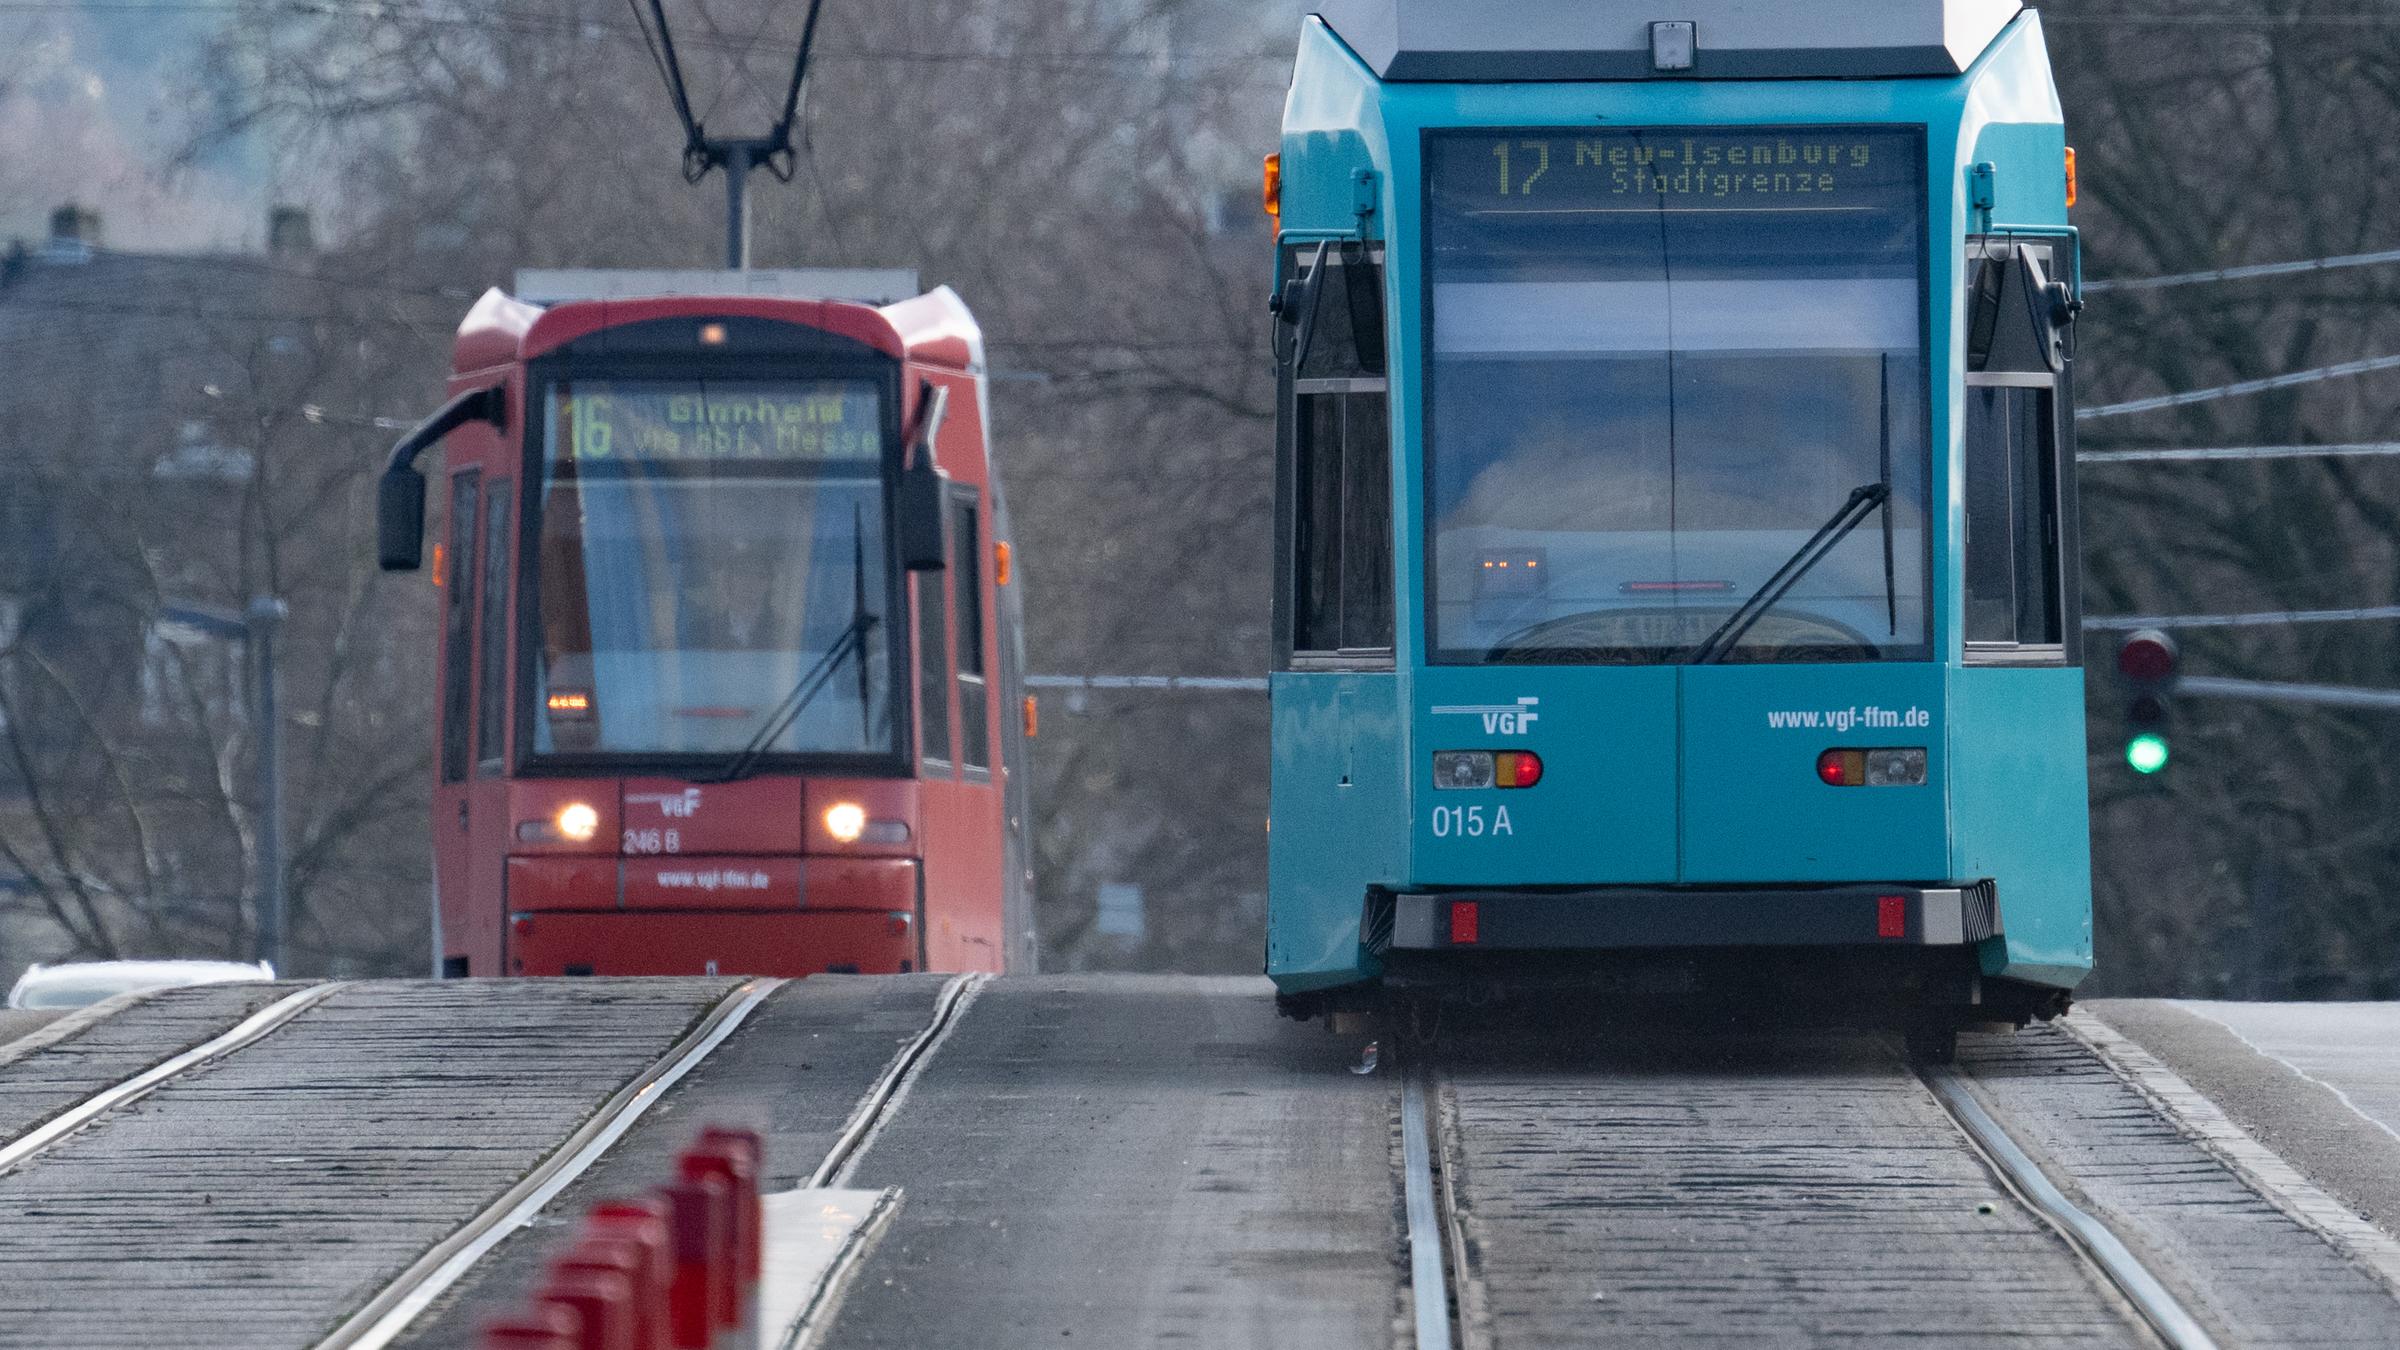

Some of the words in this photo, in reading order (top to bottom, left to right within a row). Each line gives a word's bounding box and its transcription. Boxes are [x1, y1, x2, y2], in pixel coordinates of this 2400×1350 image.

[1493, 140, 1549, 194] 17
[1575, 139, 1869, 167] Neu-Isenburg
[1611, 165, 1834, 197] Stadtgrenze
[563, 396, 613, 458] 16
[1482, 697, 1539, 735] VGF
[1767, 706, 1930, 732] www.vgf-ffm.de
[660, 788, 701, 817] VGF
[1432, 805, 1484, 837] 015
[1492, 805, 1513, 836] A
[623, 828, 661, 854] 246
